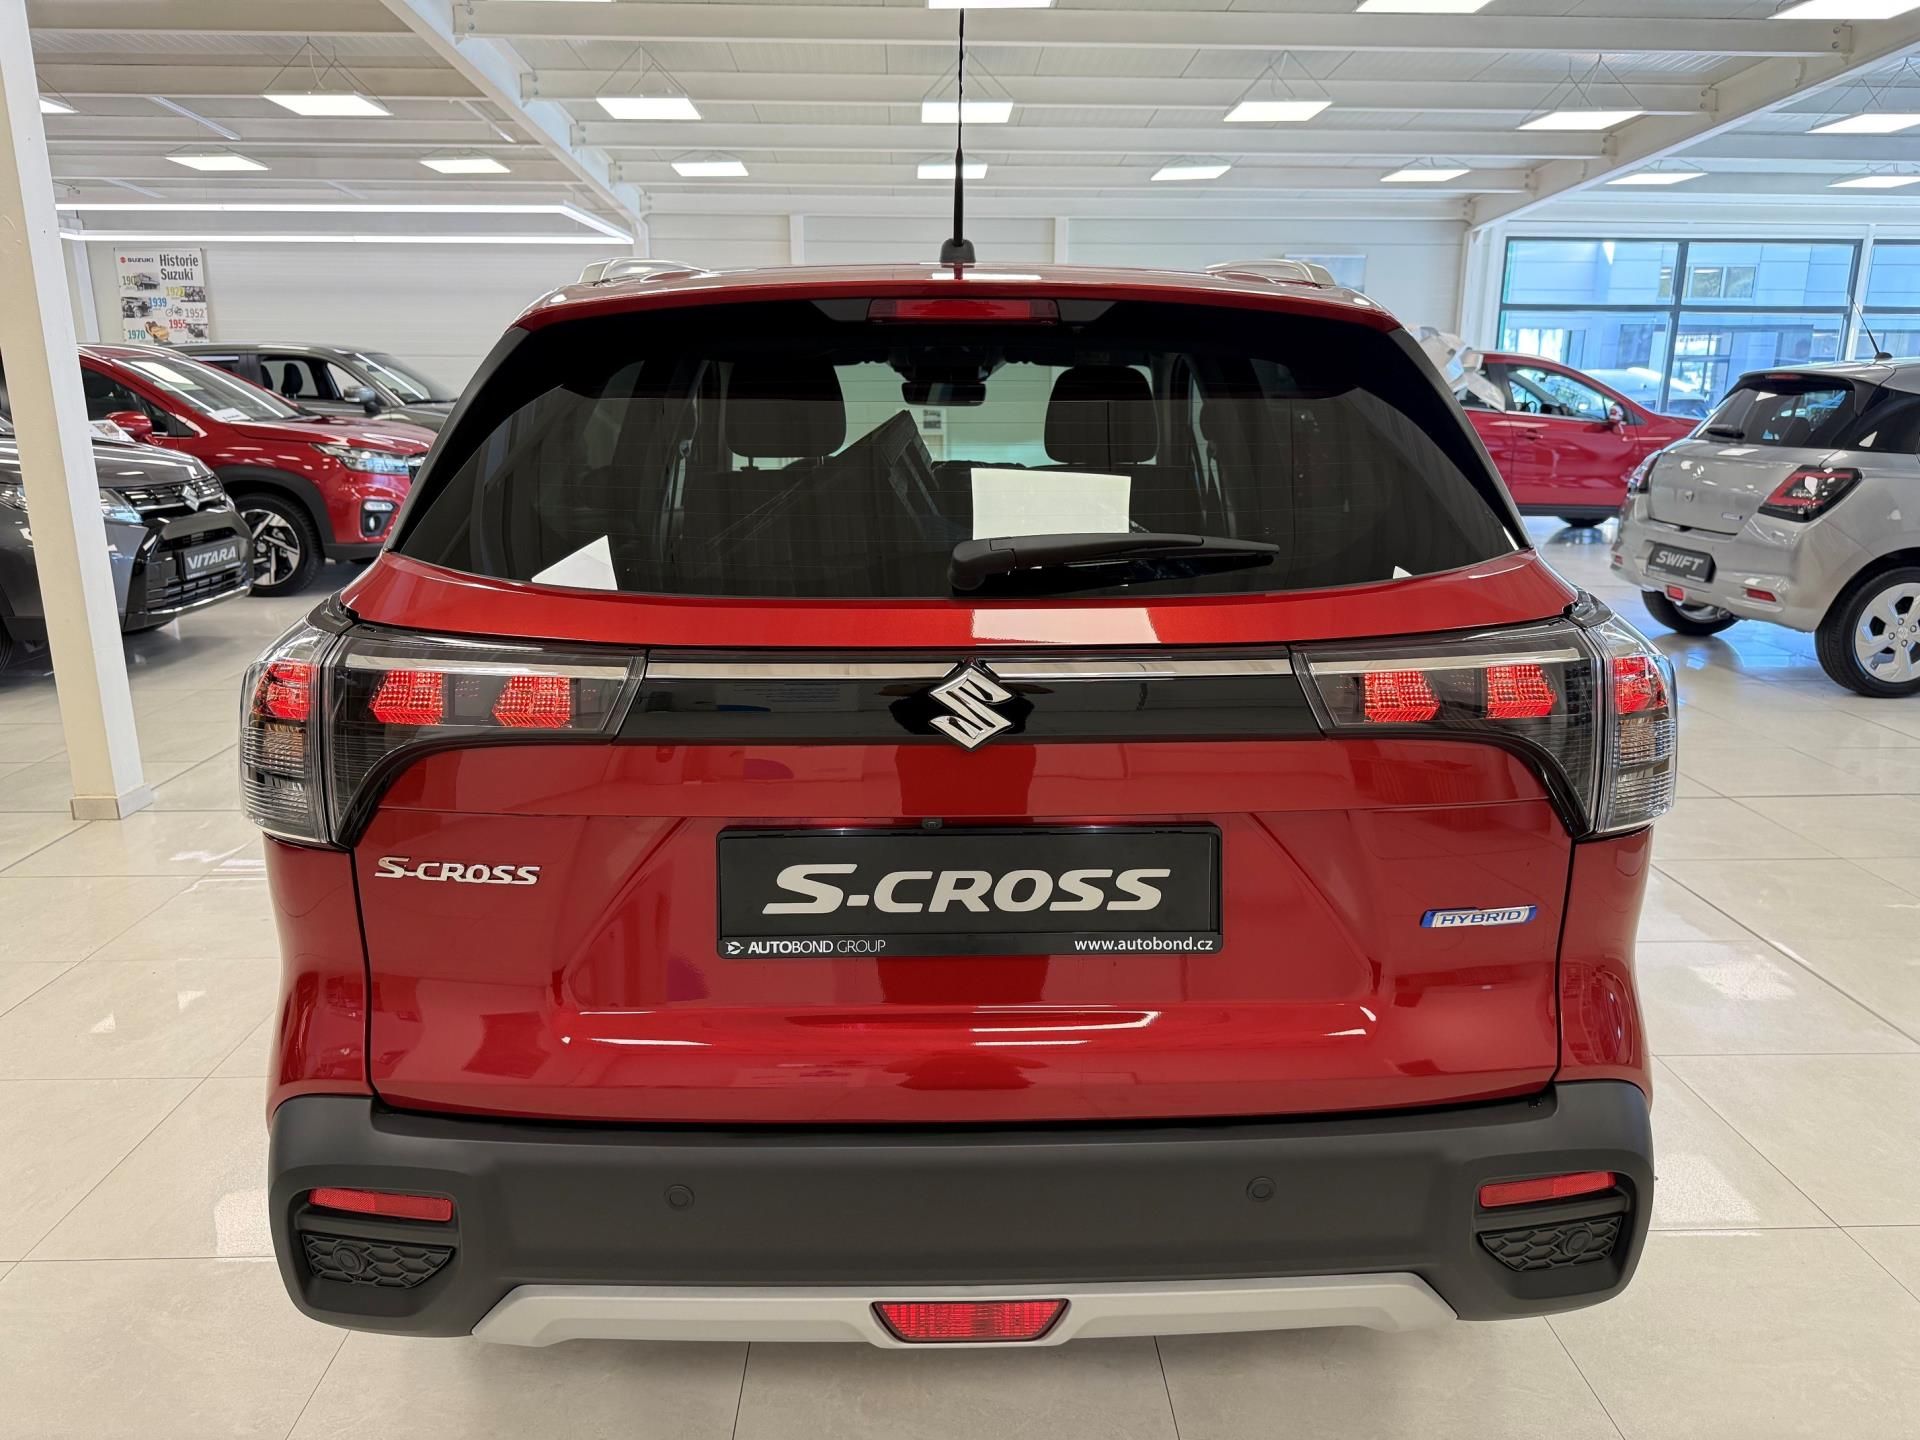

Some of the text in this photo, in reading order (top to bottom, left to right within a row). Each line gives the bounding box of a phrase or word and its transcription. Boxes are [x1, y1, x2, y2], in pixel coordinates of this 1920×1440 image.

[159, 254, 199, 267] Historie
[160, 268, 194, 281] Suzuki
[148, 297, 167, 308] 1939
[185, 309, 204, 318] 1952
[169, 319, 187, 329] 1955
[128, 330, 146, 340] 1970
[187, 546, 237, 570] VITARA
[1656, 551, 1704, 571] SWIFT
[374, 856, 541, 885] S-CROSS
[762, 863, 1171, 915] S-CROSS
[1441, 911, 1521, 925] HYBRID
[748, 940, 886, 954] AUTOBOND GROUP
[1074, 936, 1213, 951] www.autobond.cz
